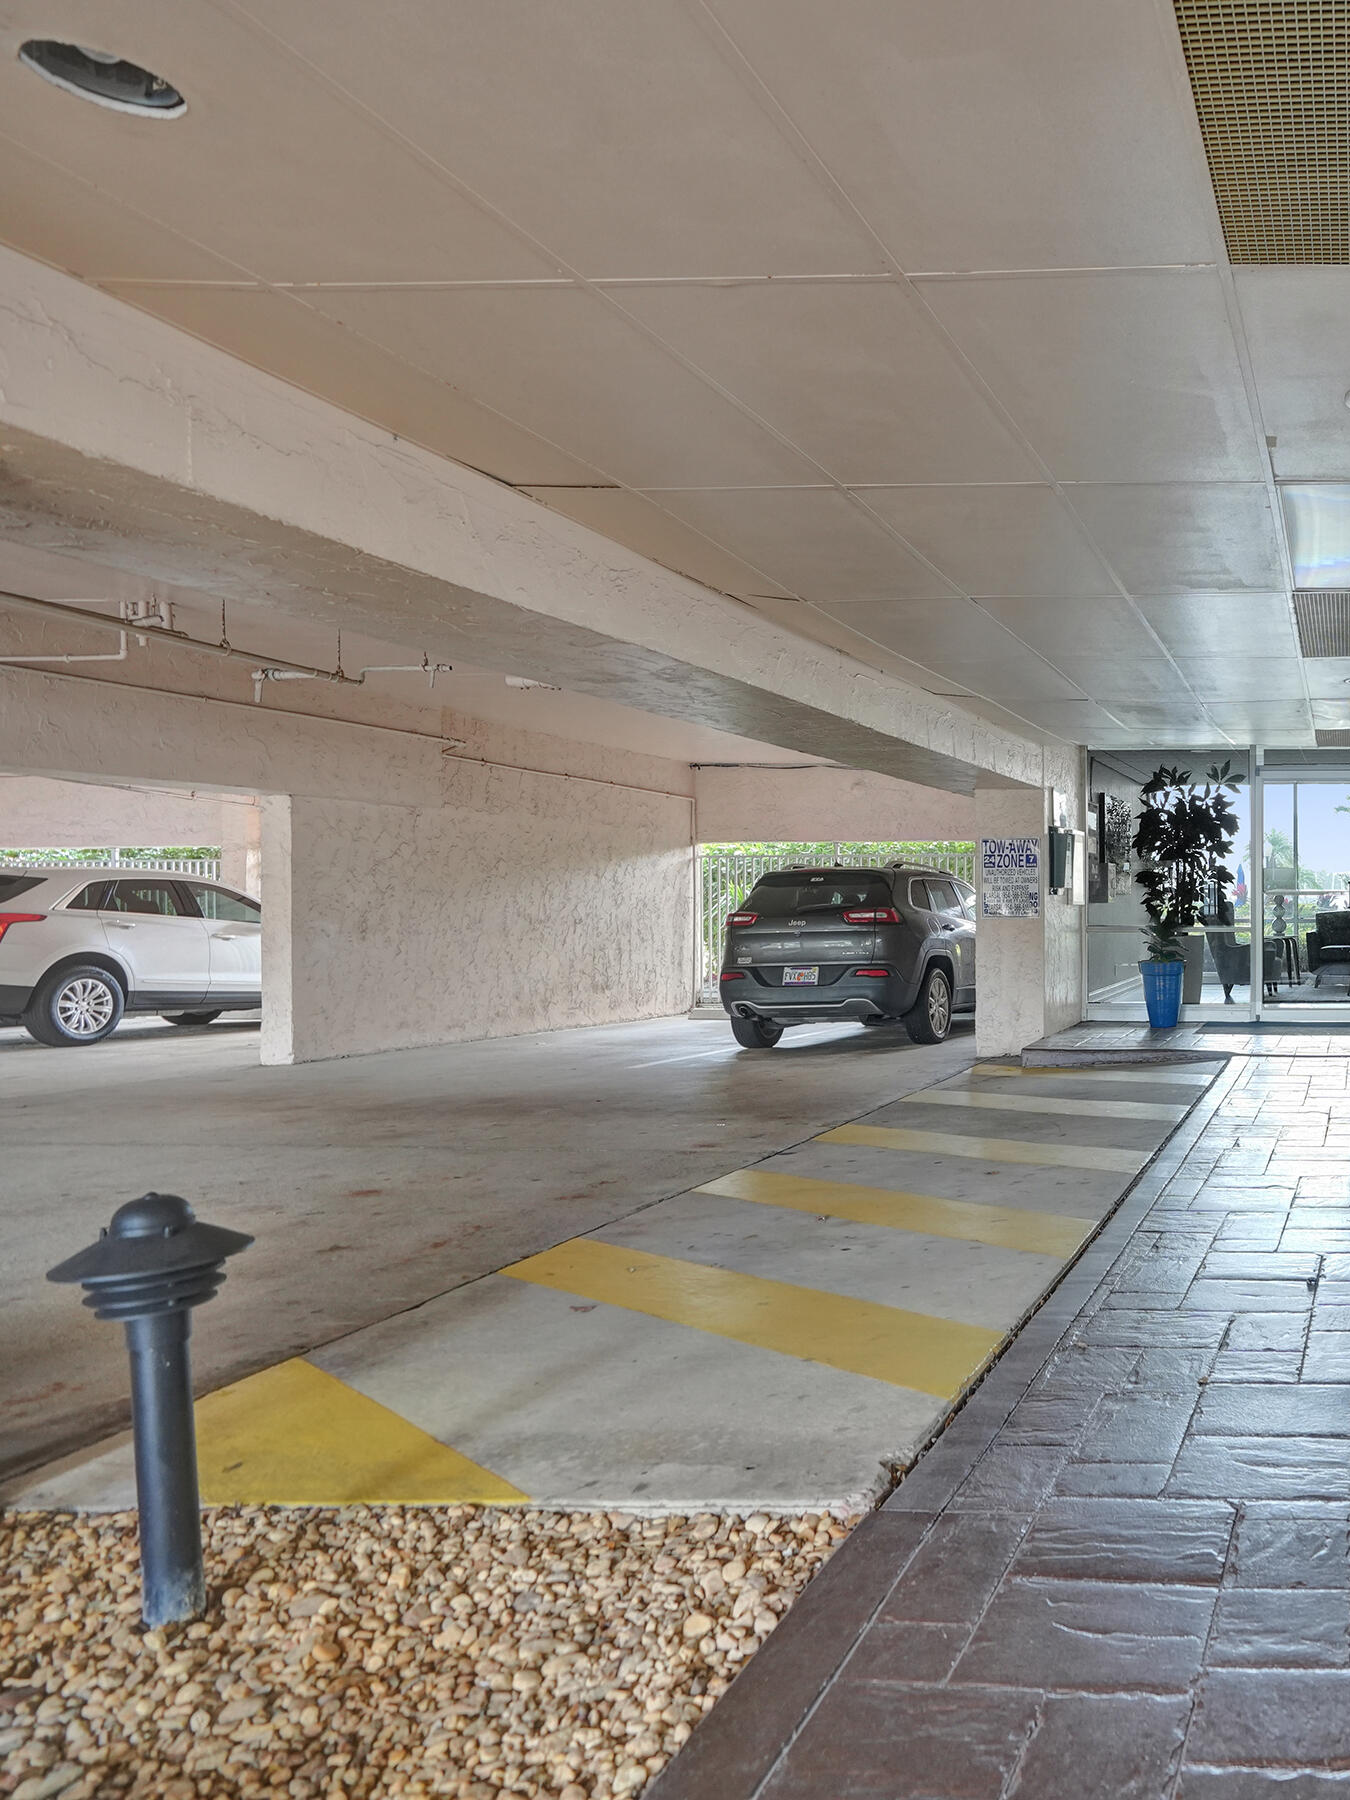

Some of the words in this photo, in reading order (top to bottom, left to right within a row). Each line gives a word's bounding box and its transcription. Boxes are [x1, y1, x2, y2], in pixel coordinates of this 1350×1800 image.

[982, 839, 1039, 853] TOW-AWAY
[984, 855, 995, 863] 24
[997, 854, 1025, 868] ZONE
[985, 868, 1016, 876] UNAUTHORIZED
[1017, 868, 1036, 876] VEHICLES
[984, 876, 993, 884] WILL
[994, 876, 999, 884] BE
[1000, 876, 1014, 884] TOWED
[1015, 876, 1020, 884] AT
